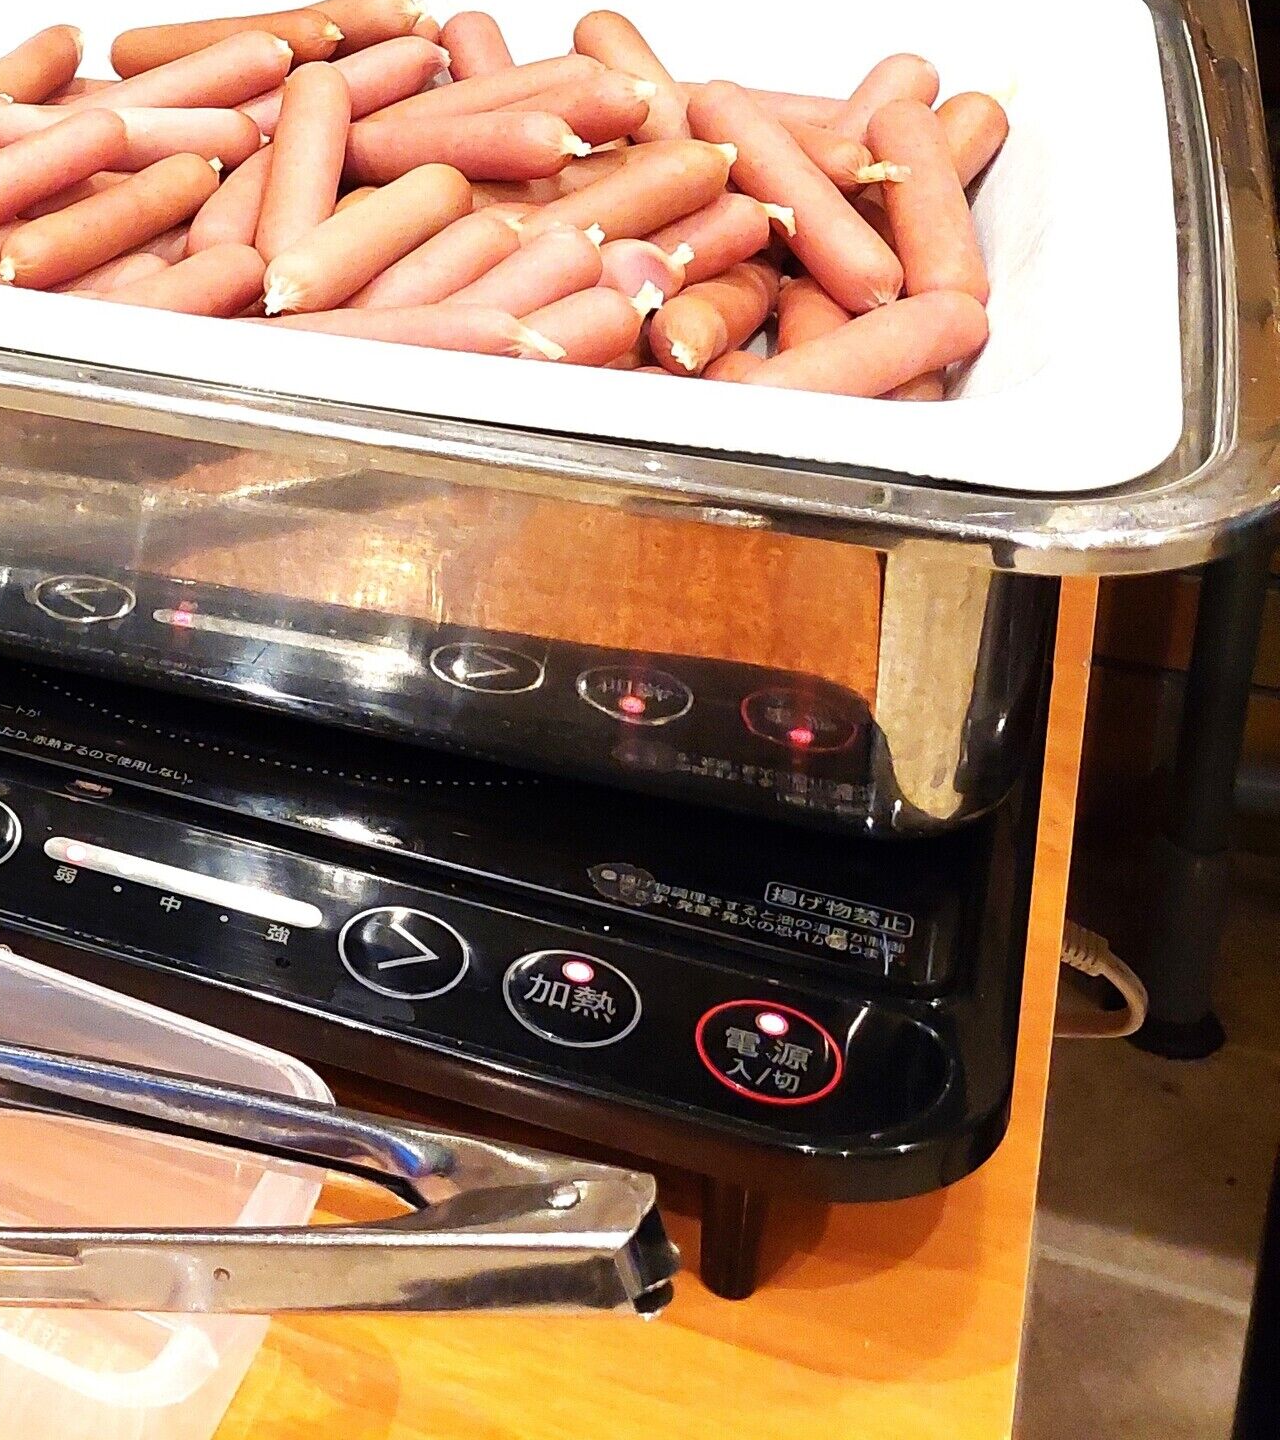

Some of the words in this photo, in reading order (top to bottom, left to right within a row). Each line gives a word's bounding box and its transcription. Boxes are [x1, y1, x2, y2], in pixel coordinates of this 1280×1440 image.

[53, 865, 78, 884] 弱
[159, 895, 182, 913] 中
[771, 886, 906, 933] 揚げ物禁止
[267, 923, 291, 946] 強
[523, 972, 617, 1024] 加熱
[726, 1026, 813, 1072] 電源
[726, 1058, 801, 1094] 入/切
